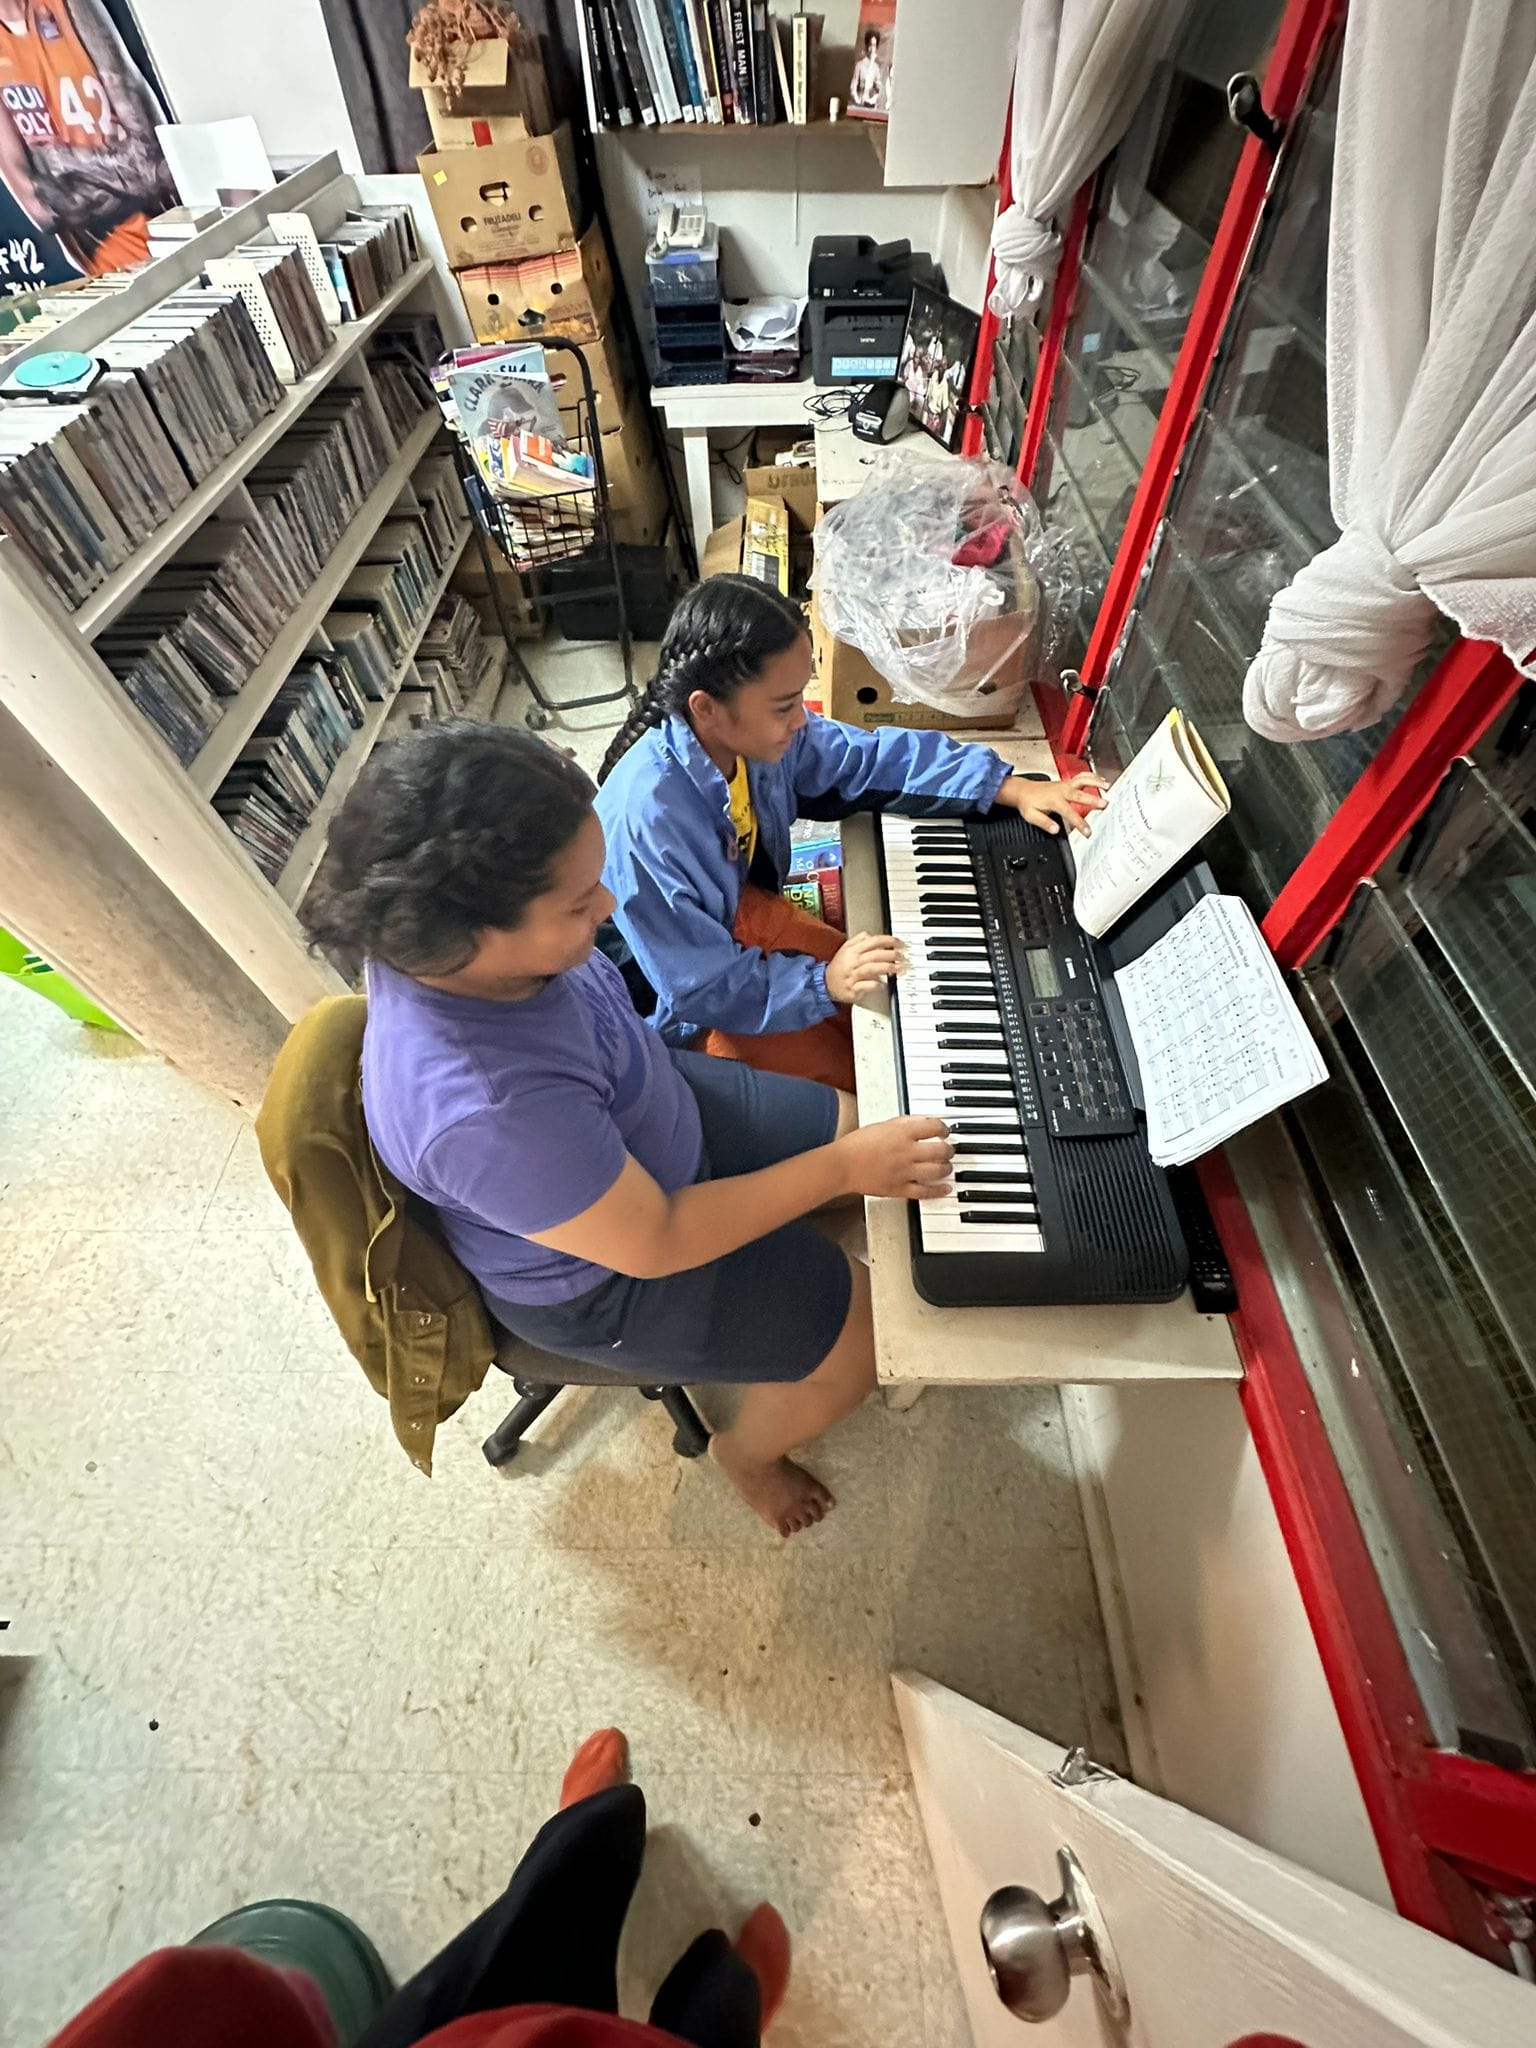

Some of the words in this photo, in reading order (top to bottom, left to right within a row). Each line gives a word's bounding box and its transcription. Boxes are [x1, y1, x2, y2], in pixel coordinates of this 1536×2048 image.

[733, 11, 744, 45] FIRST
[737, 49, 747, 75] MAN
[2, 86, 45, 110] QUI
[463, 374, 496, 411] CLARK
[823, 884, 838, 921] BRYC
